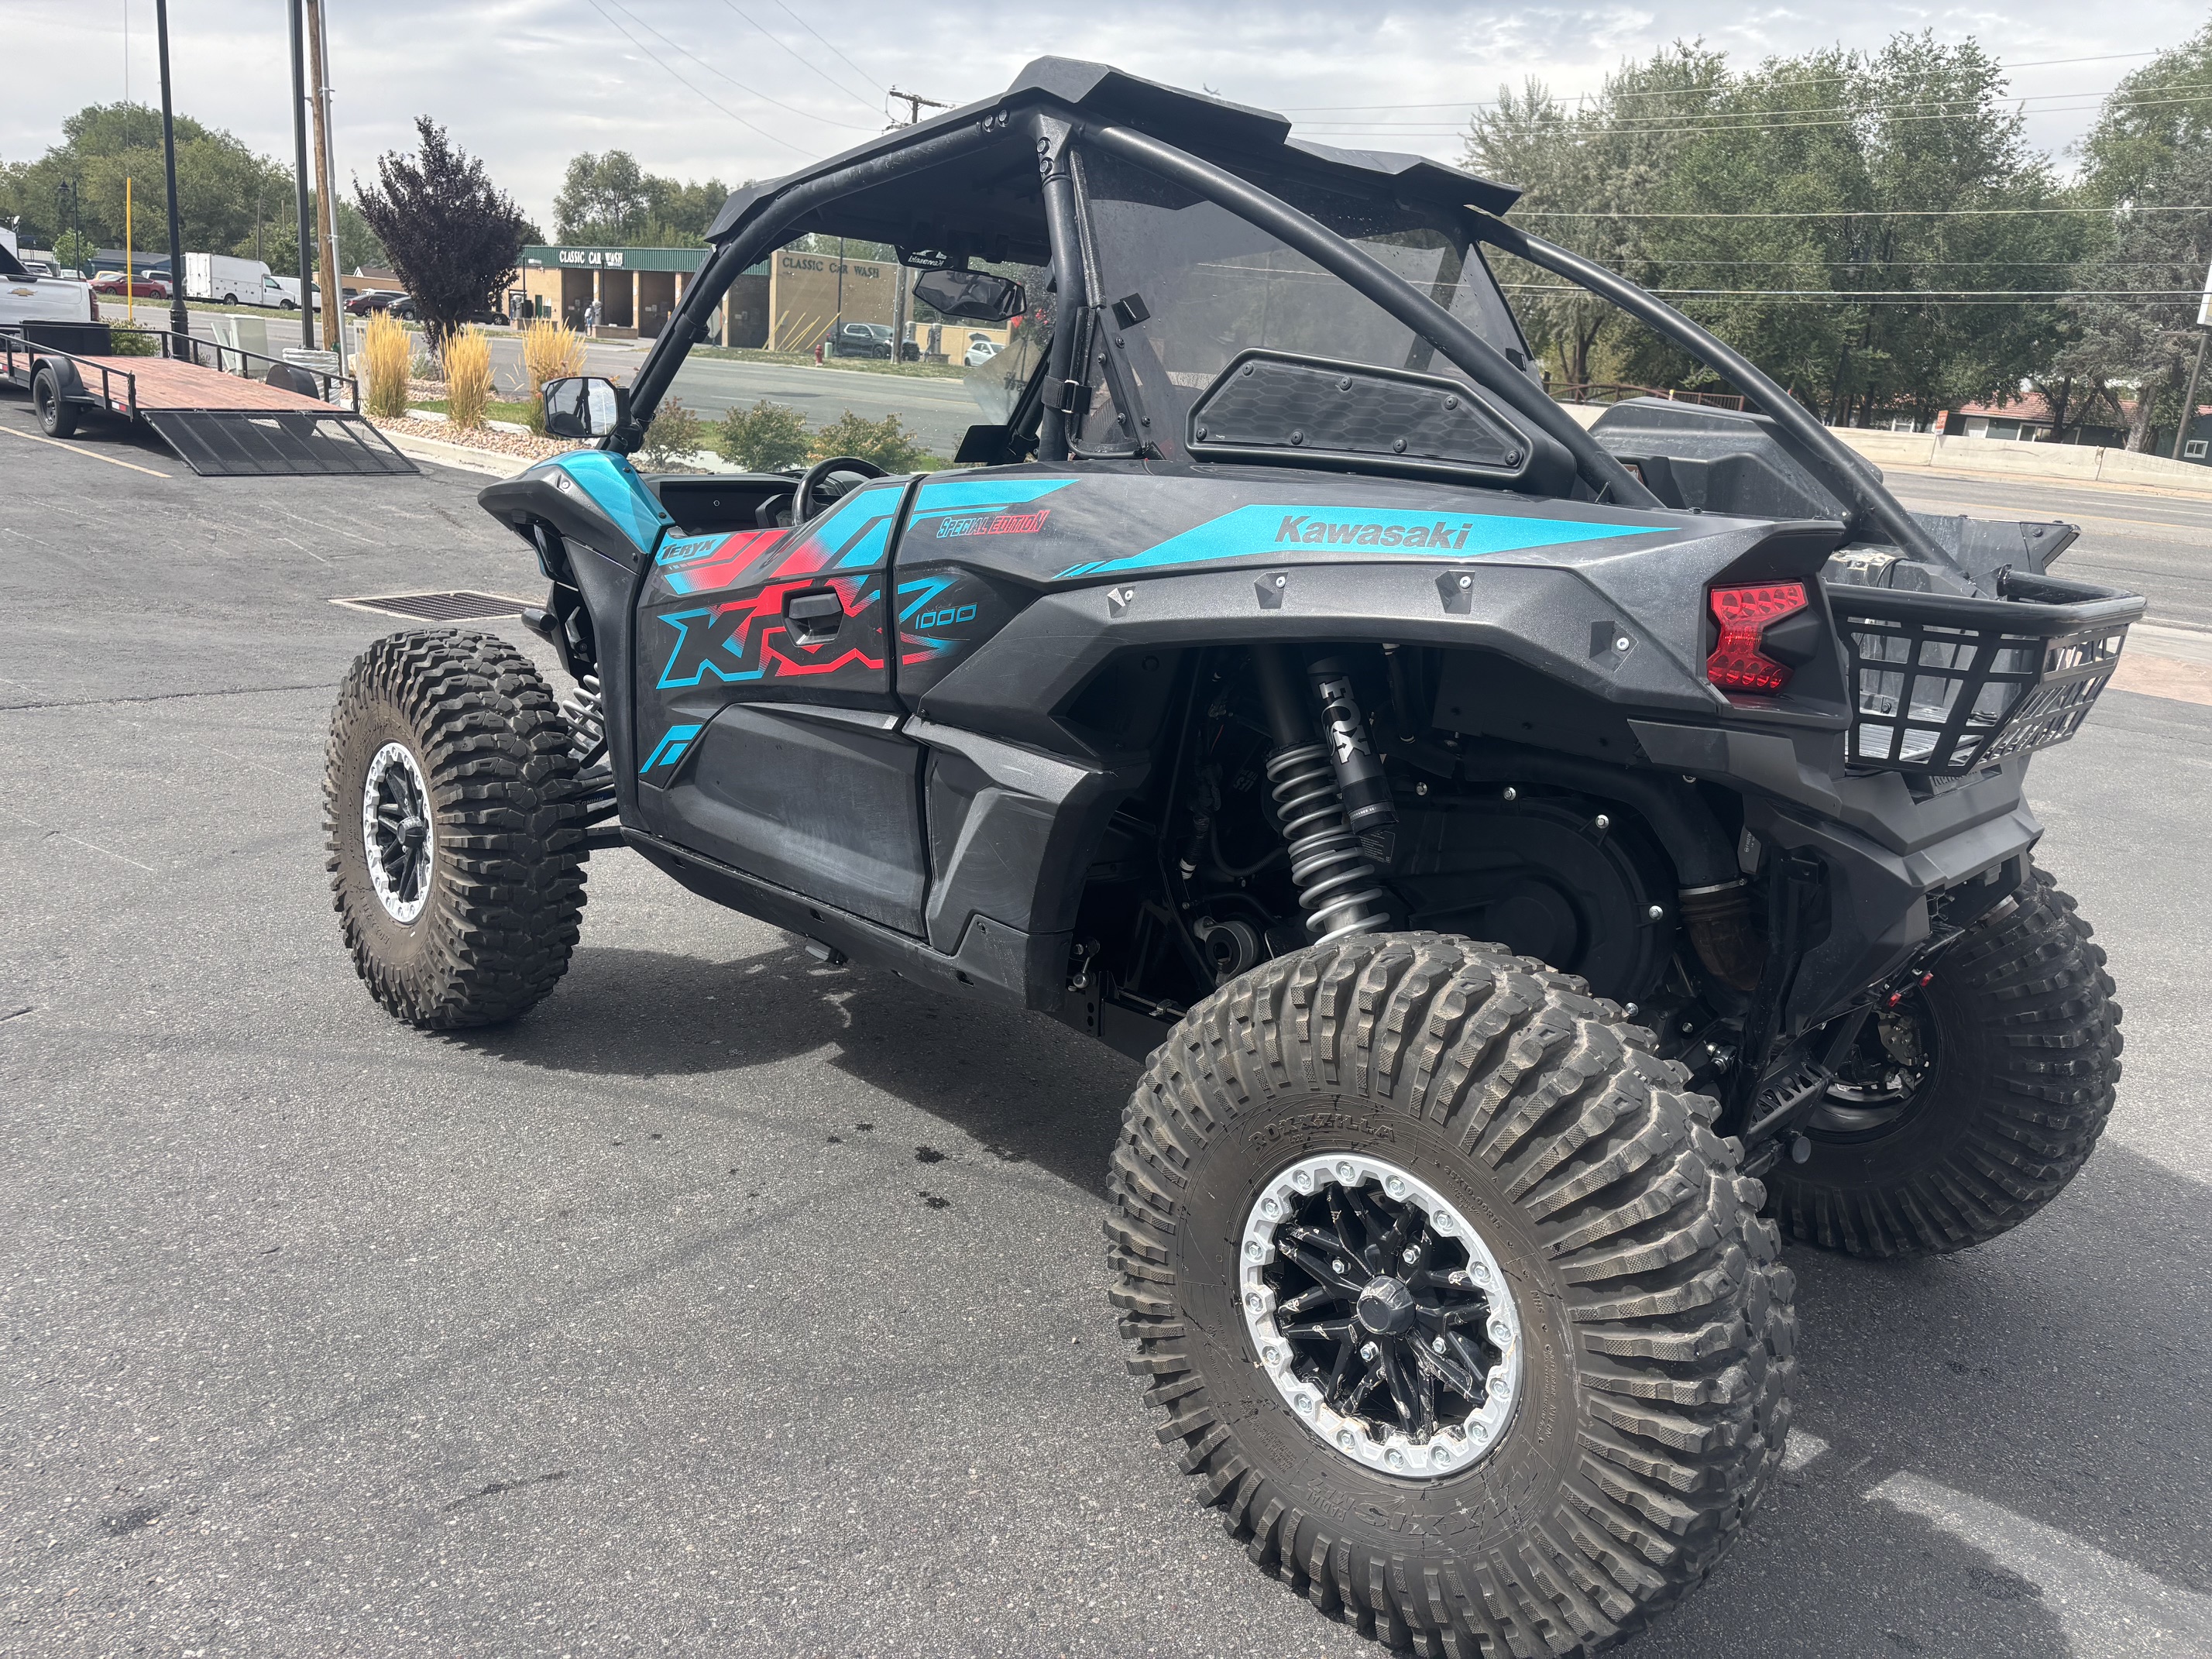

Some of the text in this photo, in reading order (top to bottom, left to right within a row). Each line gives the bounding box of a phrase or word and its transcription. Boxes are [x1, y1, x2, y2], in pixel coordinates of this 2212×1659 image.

[559, 250, 623, 264] CLASSIC CAR WASH
[782, 257, 823, 272] CLASSIC
[854, 266, 880, 278] WASH
[936, 510, 1051, 538] SPECIAL EDITION
[1275, 515, 1474, 550] Kawasaki
[915, 603, 977, 630] 1000
[1319, 675, 1371, 764] FOX
[1249, 1113, 1395, 1151] ROXXZILLA
[1305, 1487, 1348, 1523] RADIAL
